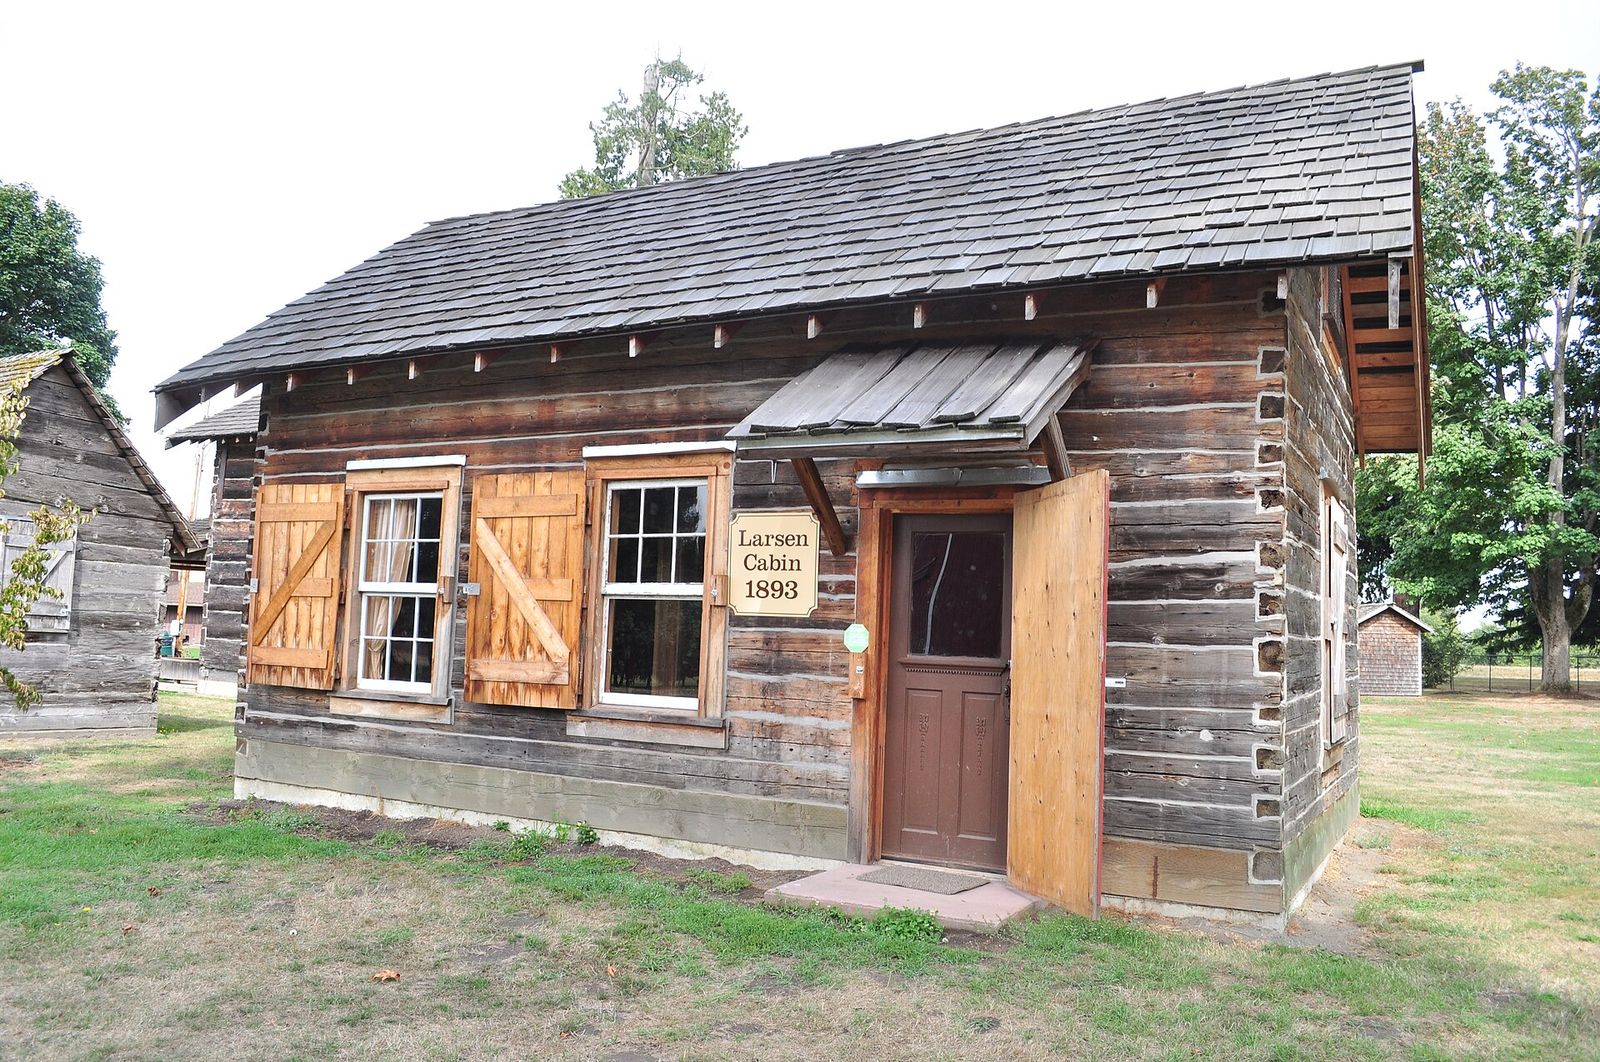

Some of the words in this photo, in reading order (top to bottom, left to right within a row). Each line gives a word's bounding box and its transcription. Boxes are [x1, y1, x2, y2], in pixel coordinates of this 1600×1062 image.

[738, 529, 809, 547] Larsen
[743, 553, 802, 572] Cabin
[745, 579, 799, 600] 1893
